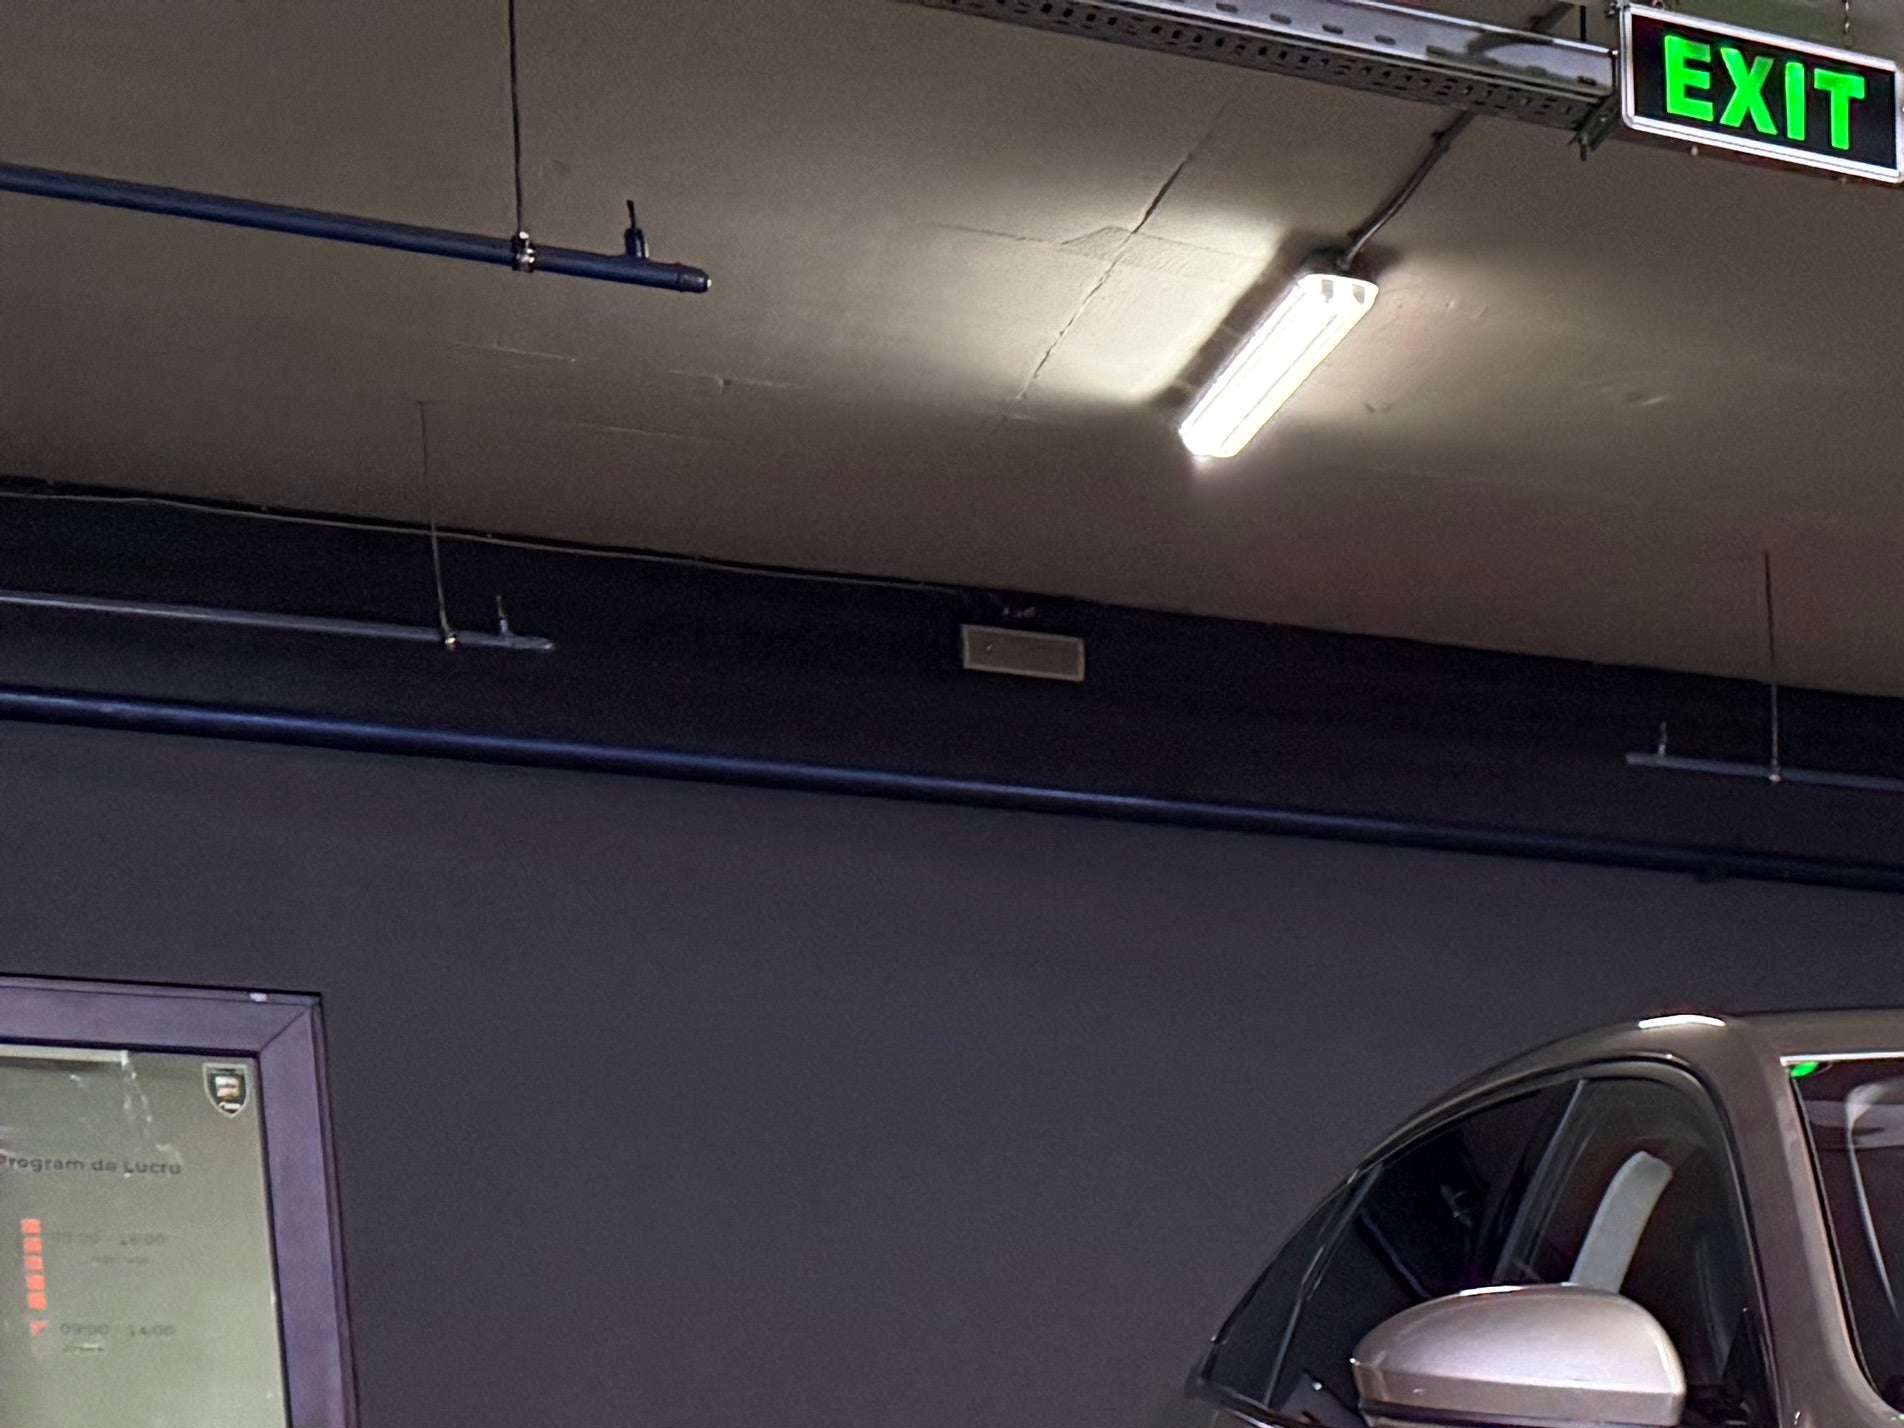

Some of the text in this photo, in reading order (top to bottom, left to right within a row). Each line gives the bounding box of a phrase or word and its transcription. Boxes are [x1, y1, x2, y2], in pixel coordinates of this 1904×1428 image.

[1663, 34, 1866, 151] EXIT
[90, 1158, 117, 1172] de
[123, 1160, 182, 1175] Lucru
